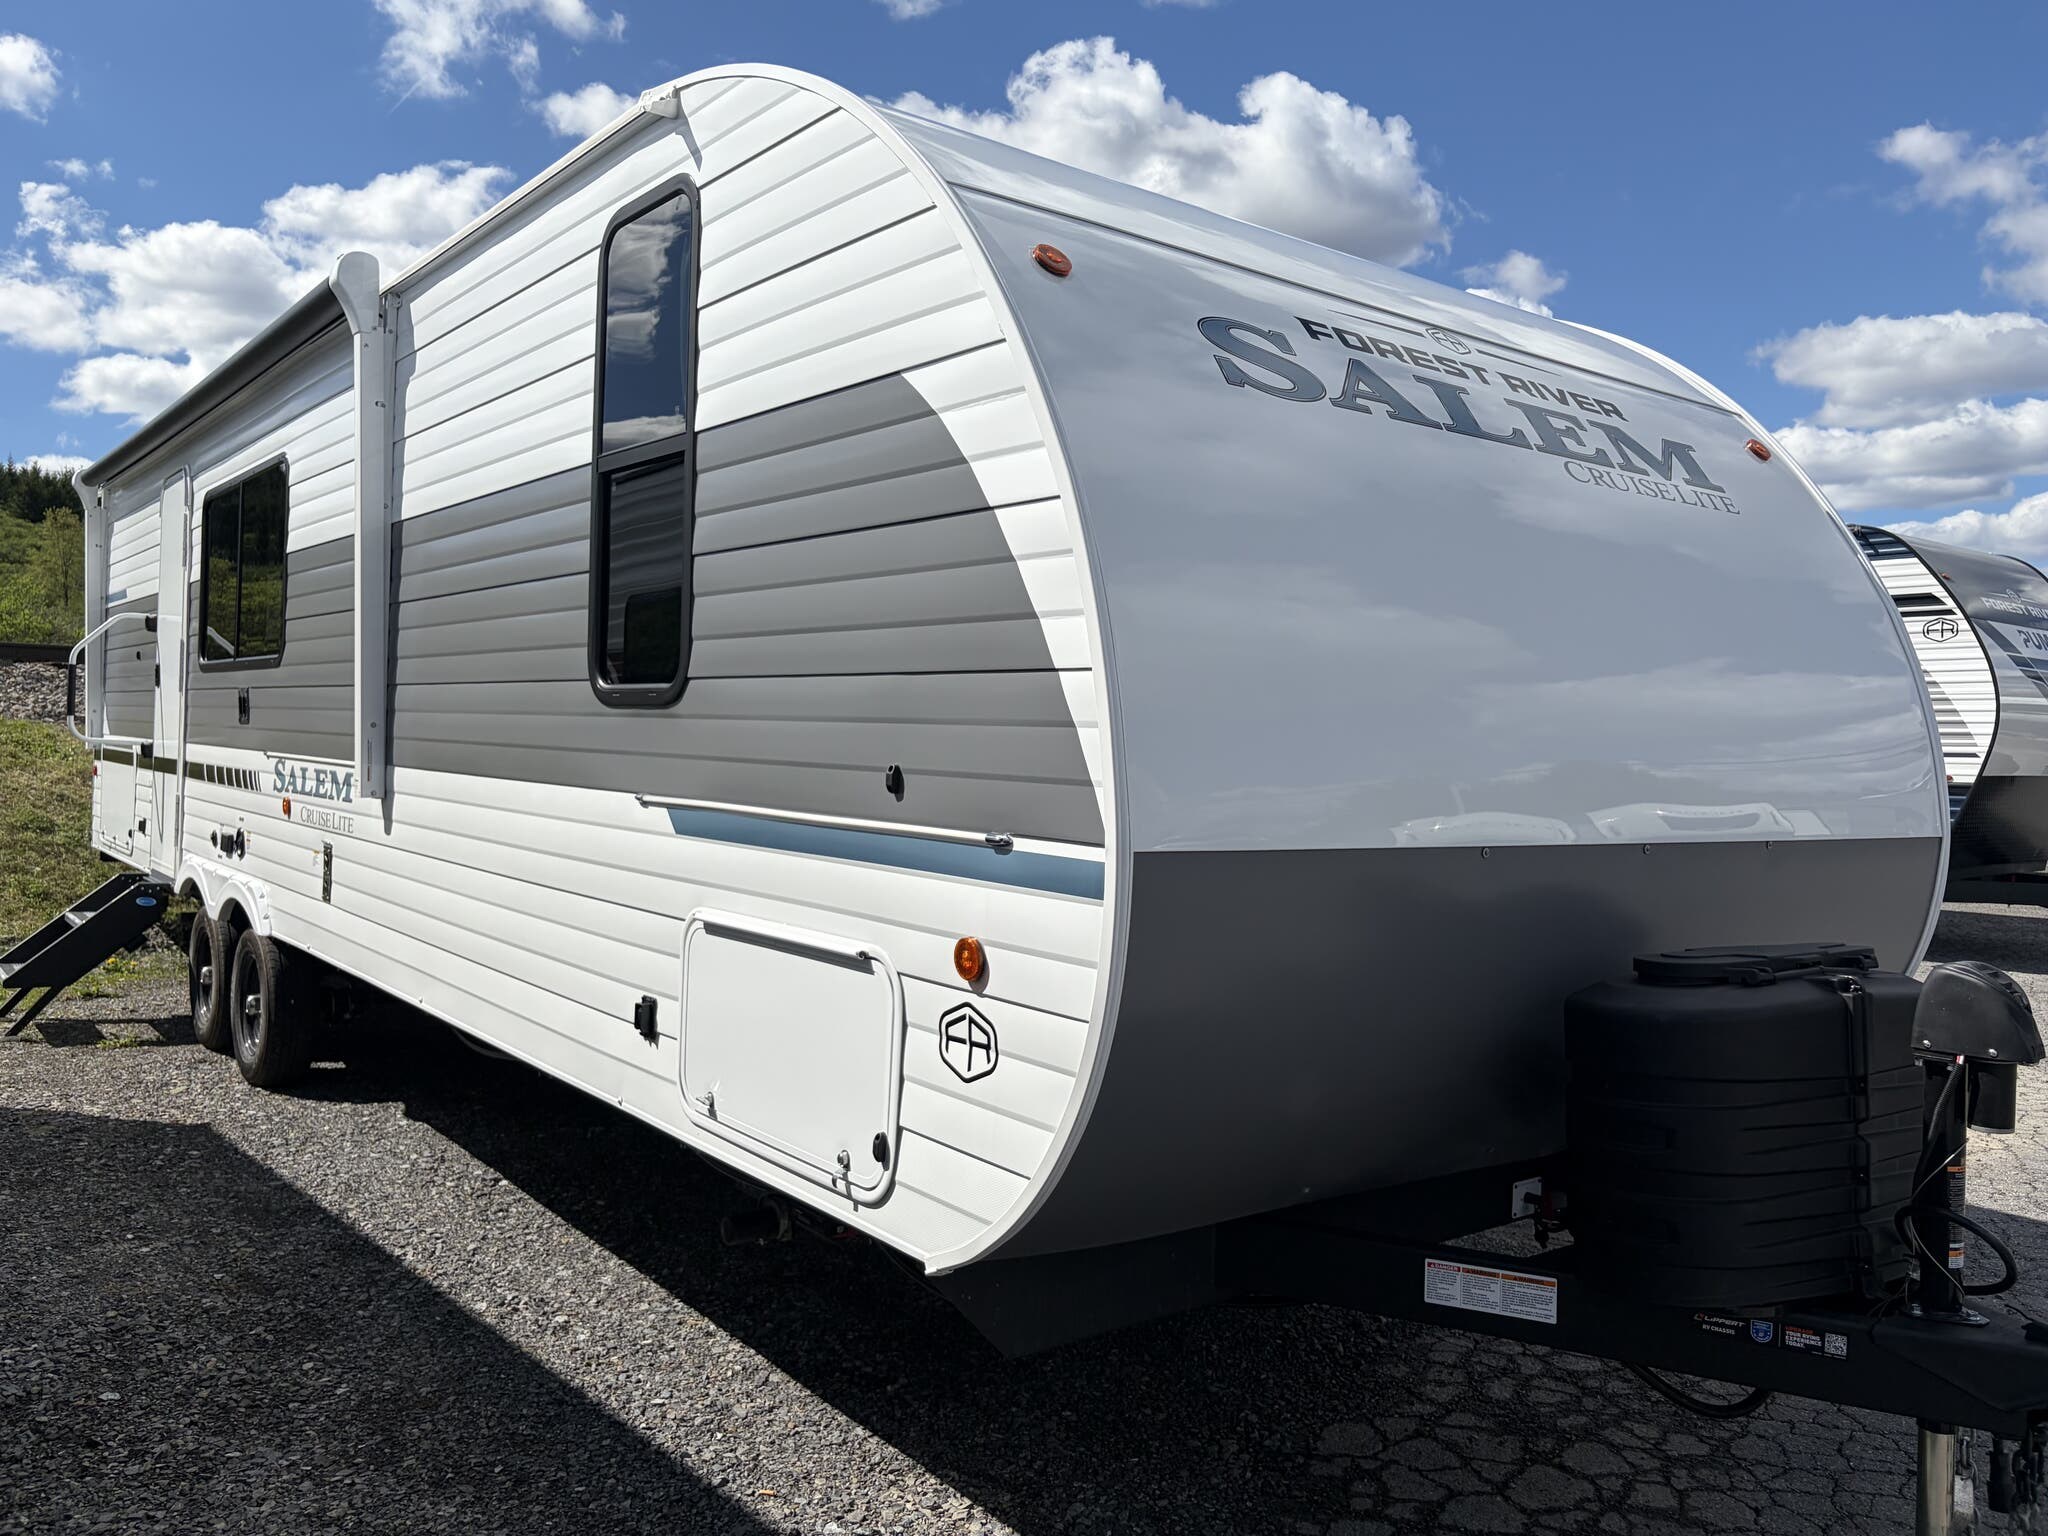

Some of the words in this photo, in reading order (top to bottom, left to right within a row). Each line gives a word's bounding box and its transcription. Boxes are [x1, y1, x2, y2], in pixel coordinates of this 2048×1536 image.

[1293, 316, 1491, 386] FOREST
[1496, 369, 1630, 422] RIVER
[1196, 315, 1726, 493] SALEM
[1562, 459, 1741, 515] CRUISELITE
[1980, 597, 2028, 616] FOREST
[273, 758, 354, 803] SALEM
[300, 805, 354, 834] CRUISELITE
[1785, 1336, 1823, 1347] EXPERIENCE
